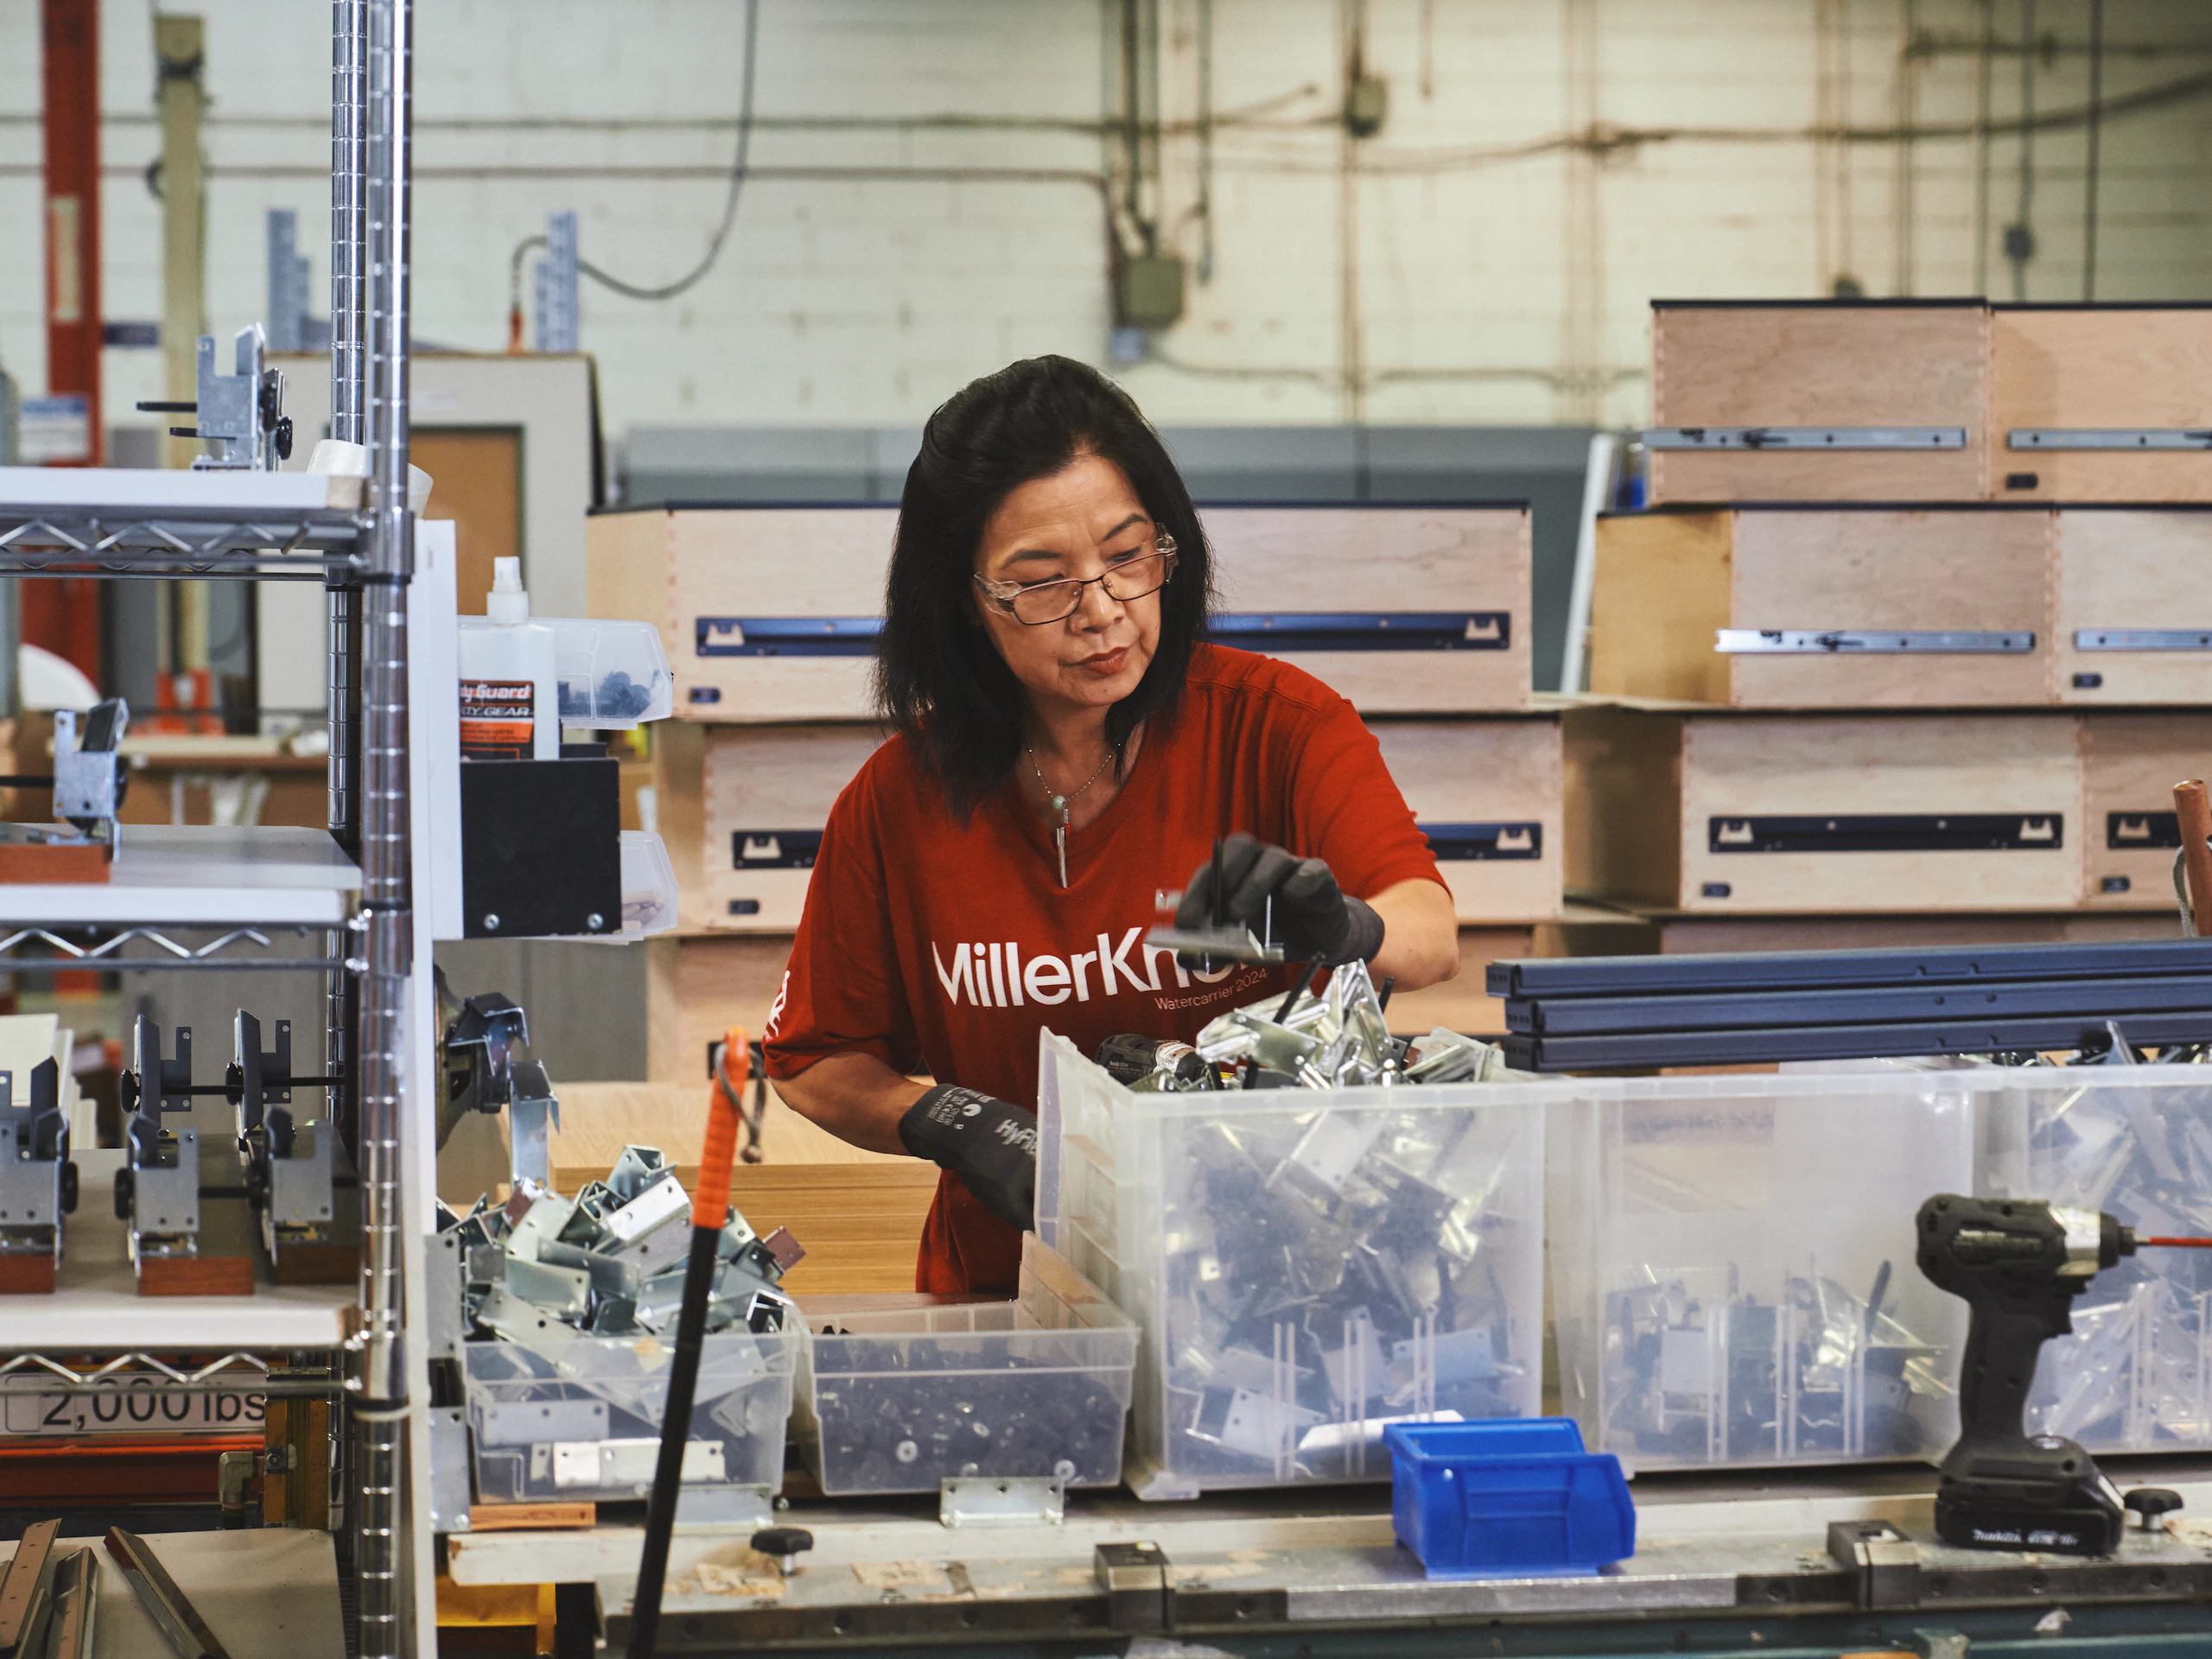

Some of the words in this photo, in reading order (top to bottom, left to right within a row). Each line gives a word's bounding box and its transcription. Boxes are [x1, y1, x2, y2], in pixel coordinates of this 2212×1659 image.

[484, 707, 530, 716] GEAR
[932, 926, 1249, 1007] MillerKn
[1154, 984, 1235, 1010] Watercarrier
[1236, 968, 1268, 992] 2024
[43, 1377, 191, 1430] 2,000
[203, 1382, 265, 1422] lbs
